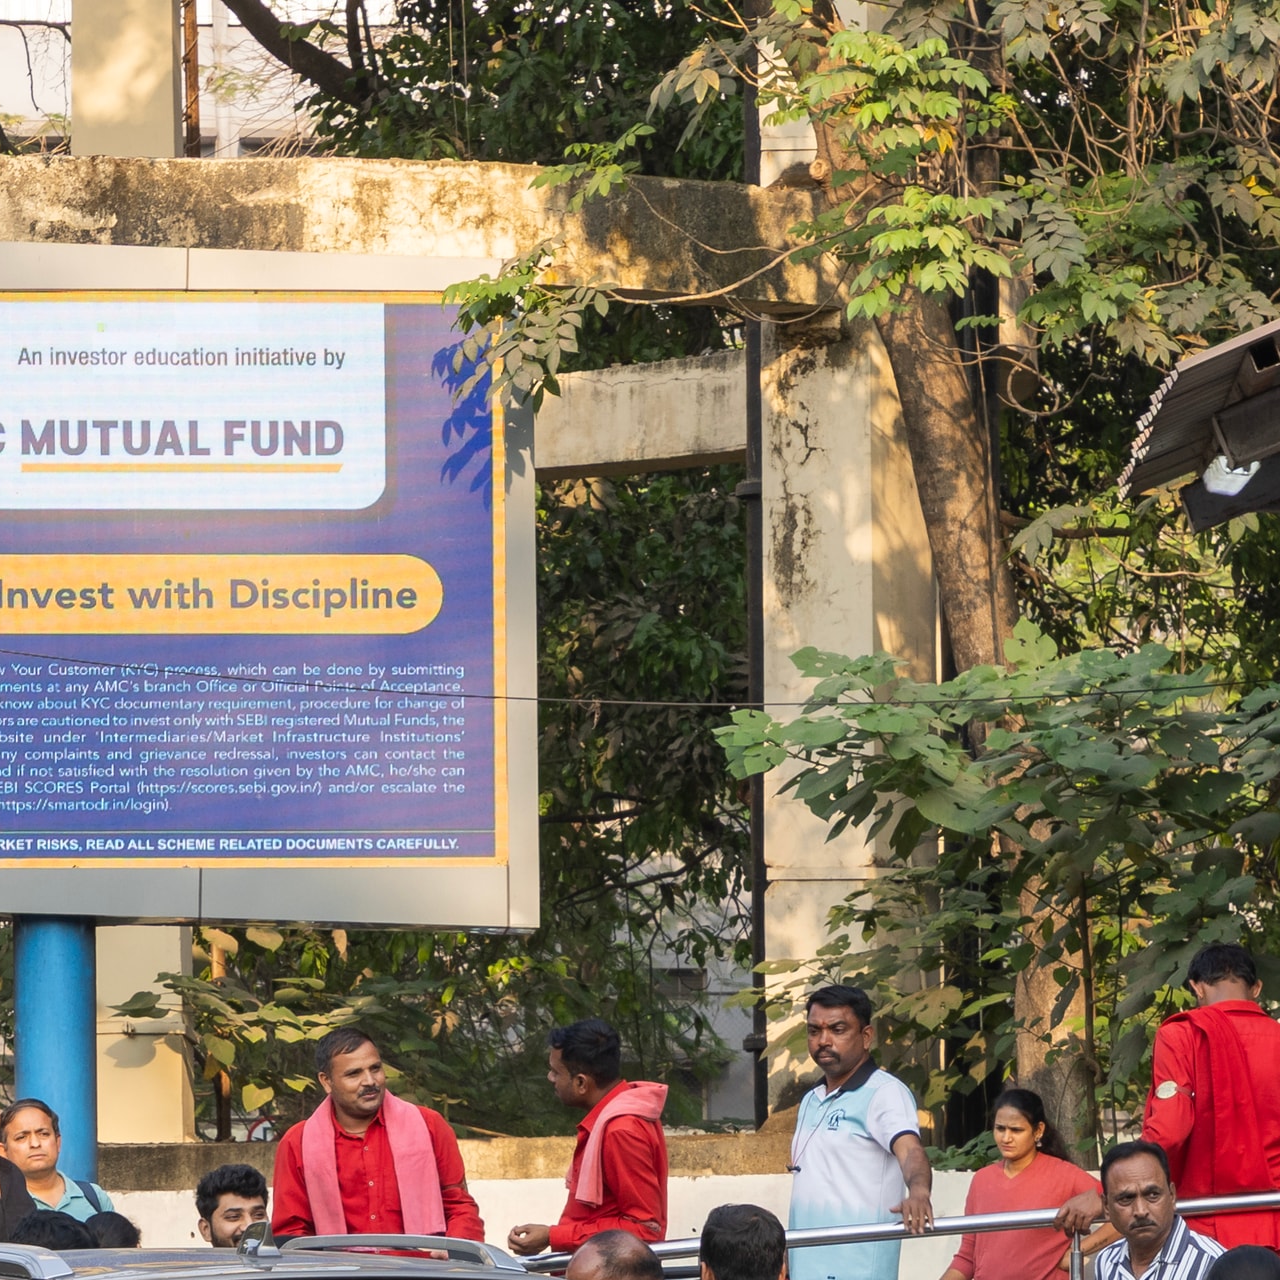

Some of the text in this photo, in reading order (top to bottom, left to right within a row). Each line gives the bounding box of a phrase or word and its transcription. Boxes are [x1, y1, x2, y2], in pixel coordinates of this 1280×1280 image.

[18, 347, 345, 369] An investor education initiative by
[21, 420, 210, 456] MUTUAL
[225, 420, 344, 456] FUND
[128, 578, 213, 610] with
[231, 578, 418, 619] Discipline
[37, 697, 77, 709] about
[80, 697, 111, 709] KYC
[114, 697, 205, 712] documentary
[208, 698, 297, 712] requirement,
[299, 697, 371, 712] procedure
[374, 697, 394, 708] for
[396, 697, 448, 712] change
[450, 697, 465, 709] of
[43, 731, 87, 743] under
[272, 731, 371, 742] Infrastructure
[24, 748, 101, 762] complaints
[106, 748, 133, 760] and
[139, 748, 207, 762] grievance
[213, 748, 279, 760] redressal,
[286, 750, 347, 760] investors
[353, 751, 378, 760] can
[384, 750, 436, 760] contact
[442, 748, 465, 759] the
[36, 839, 83, 850] RISKS,
[85, 839, 126, 850] READ
[127, 839, 155, 850] ALL
[157, 838, 216, 850] SCHEME
[219, 838, 283, 849] RELATED
[285, 838, 374, 849] DOCUMENTS
[375, 838, 460, 849] CAREFULLY.
